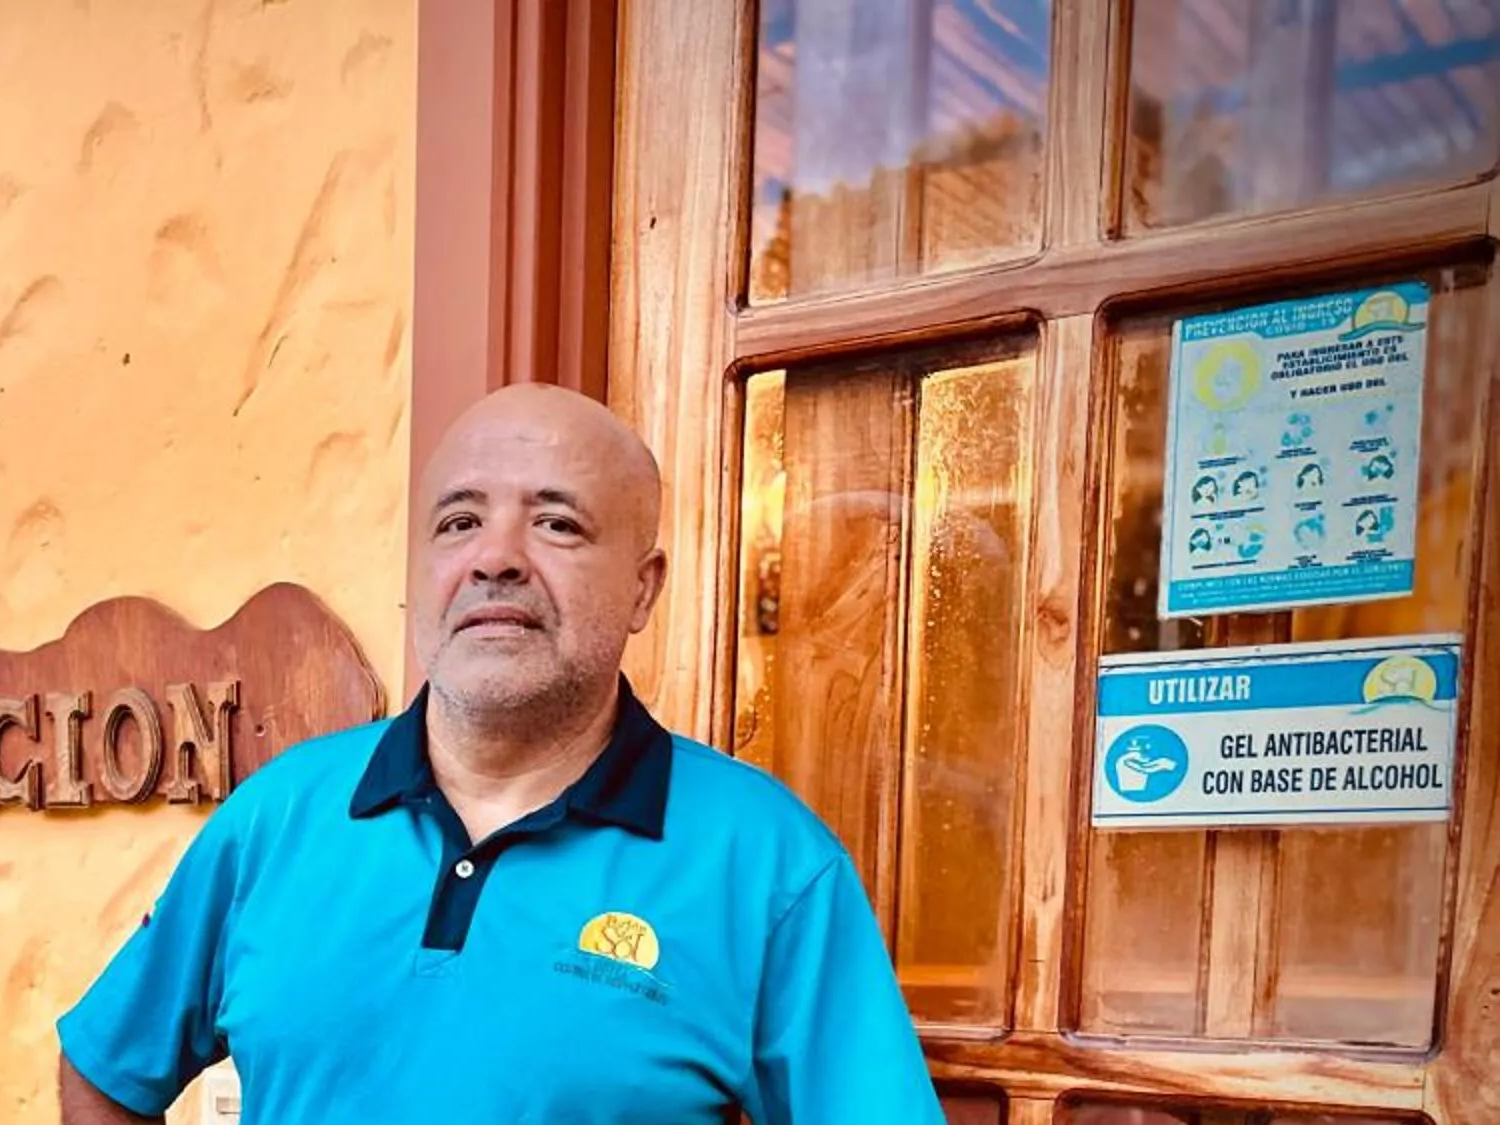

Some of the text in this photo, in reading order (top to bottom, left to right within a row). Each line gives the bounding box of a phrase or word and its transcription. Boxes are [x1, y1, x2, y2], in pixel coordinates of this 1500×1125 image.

[1271, 309, 1286, 325] AL
[1293, 298, 1353, 321] INGRESO
[1277, 350, 1304, 363] PARA
[1308, 342, 1363, 357] INGRESAR
[1290, 390, 1297, 399] Y
[1300, 383, 1337, 397] HACER
[1148, 675, 1251, 705] UTILIZAR
[1220, 728, 1428, 759] GEL ANTIBACTERIAL
[1202, 763, 1443, 795] CON BASE DE ALCOHOL
[594, 926, 645, 962] Sol
